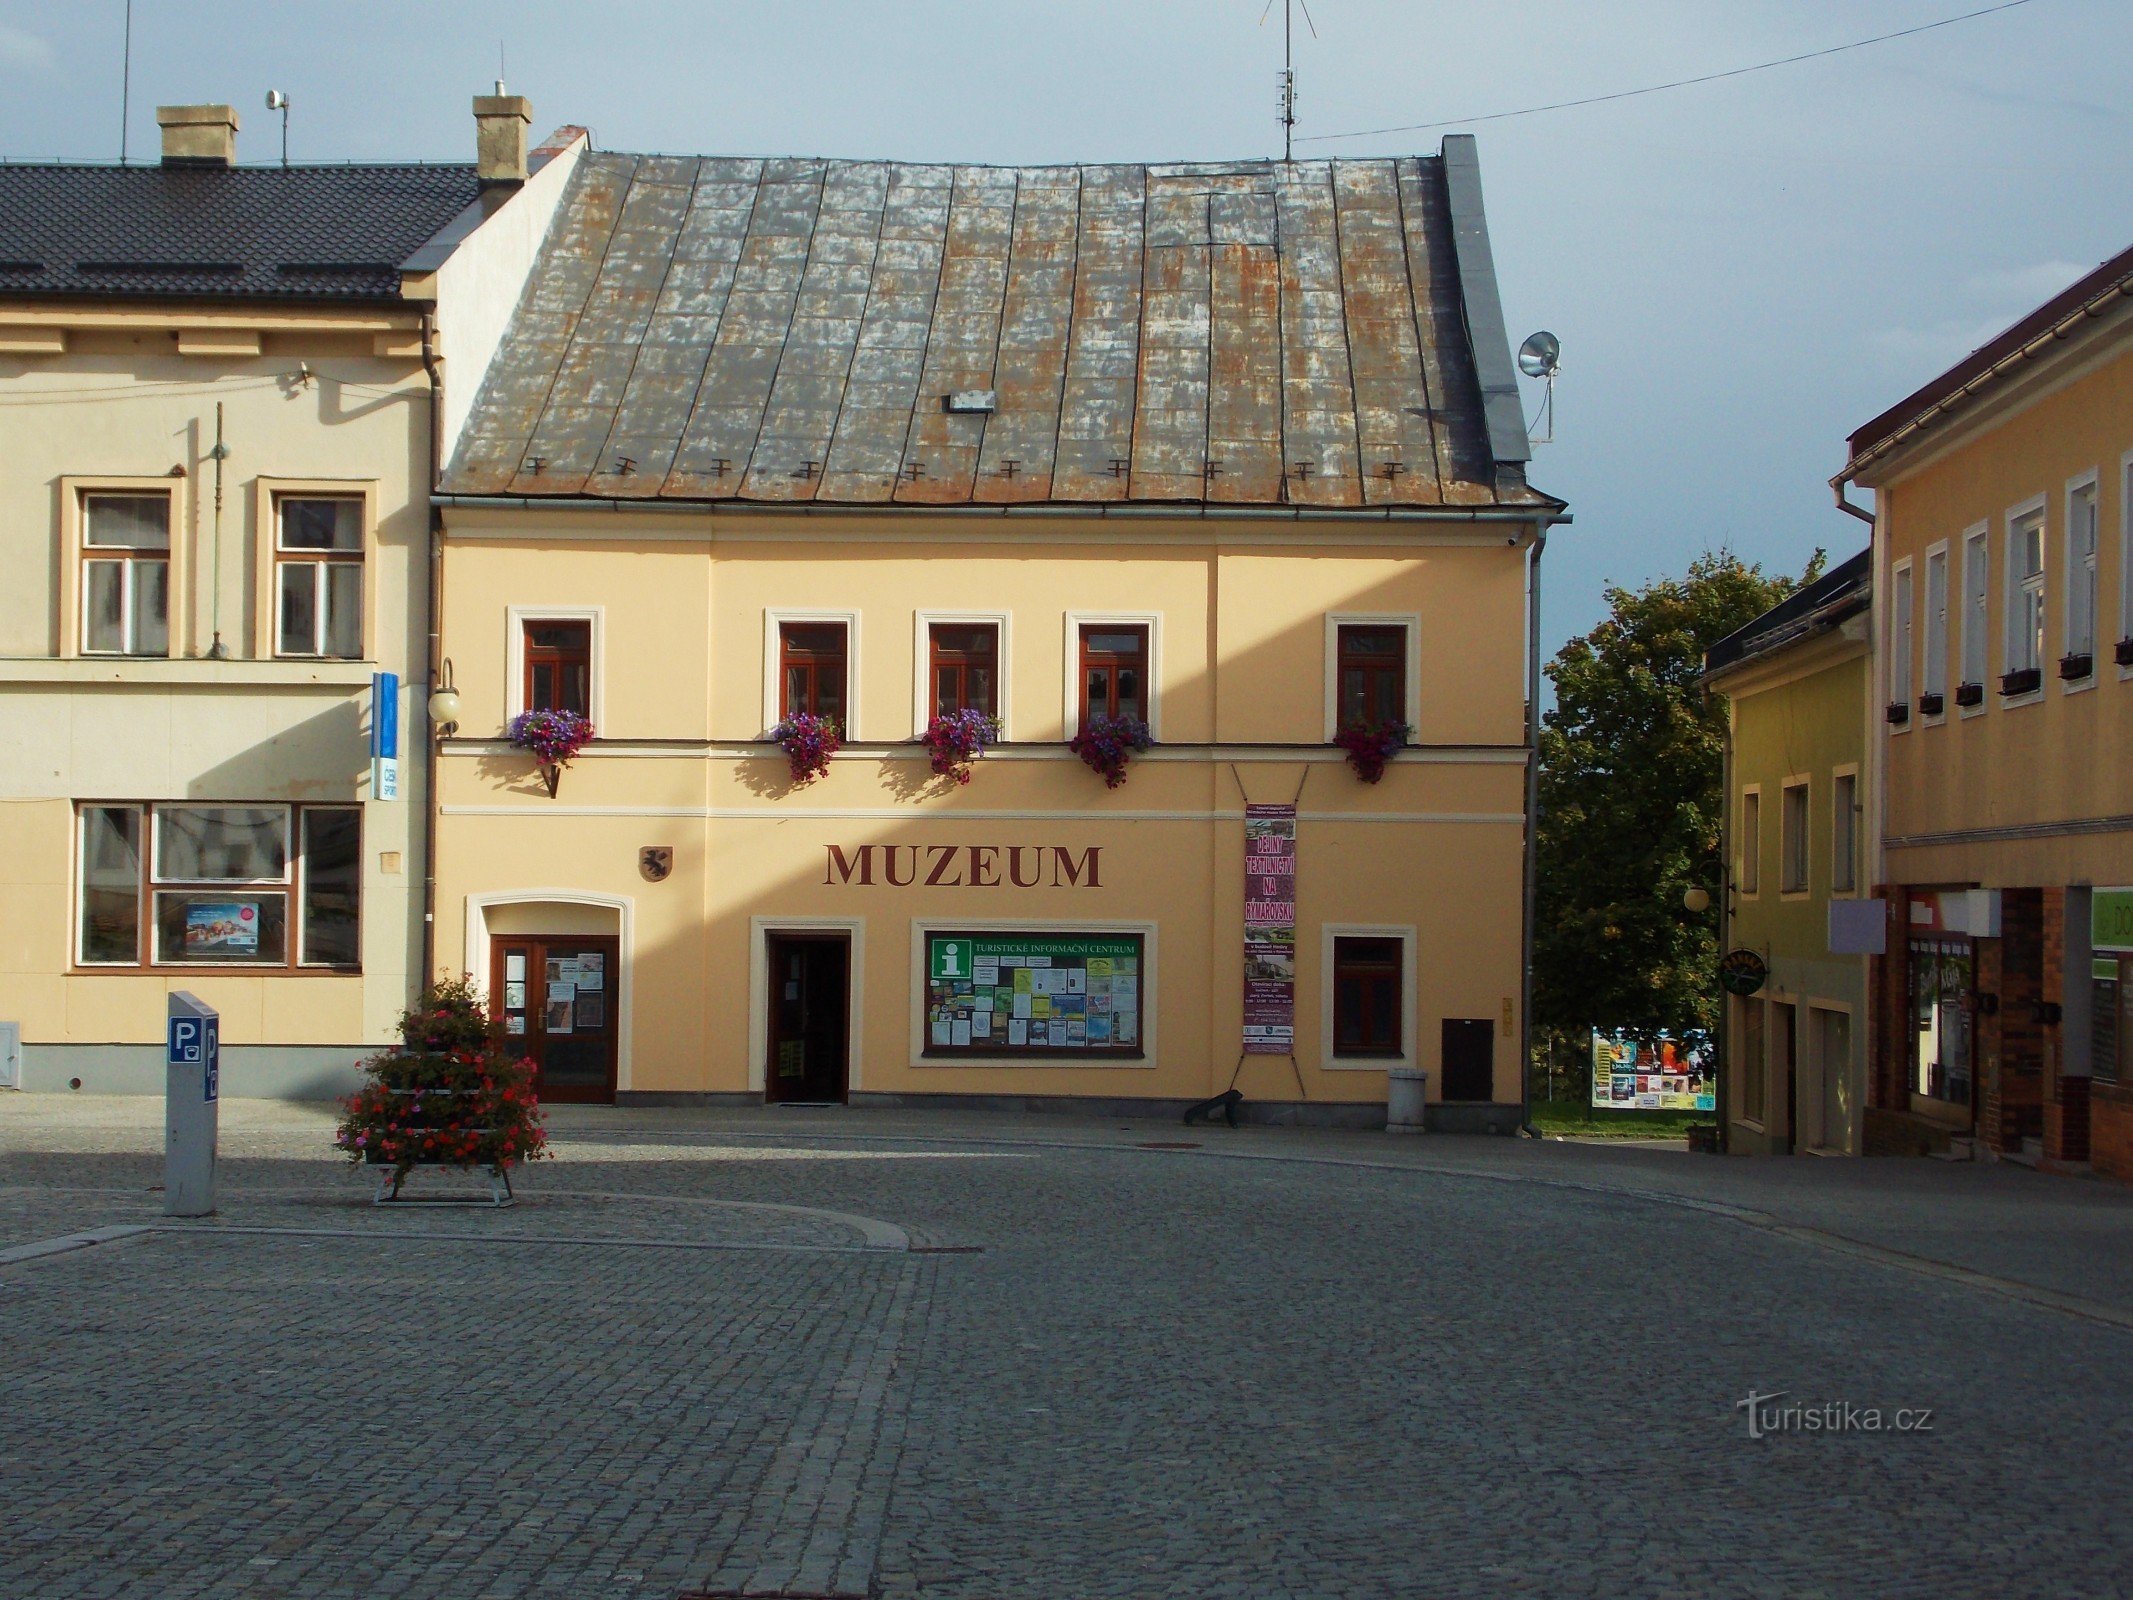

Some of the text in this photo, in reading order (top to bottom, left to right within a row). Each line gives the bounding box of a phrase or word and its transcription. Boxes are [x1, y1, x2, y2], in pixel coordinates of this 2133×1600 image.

[822, 844, 1103, 887] MUZEUM
[1246, 852, 1295, 875] TEXTILNICTVÍ
[1263, 876, 1276, 895] NA
[1246, 897, 1295, 921] RÝMAŘOVSKU
[976, 942, 1135, 954] TURISTICKÉ INFORMAČNÍ CENTRUM
[176, 1022, 196, 1049] P
[207, 1028, 216, 1077] P
